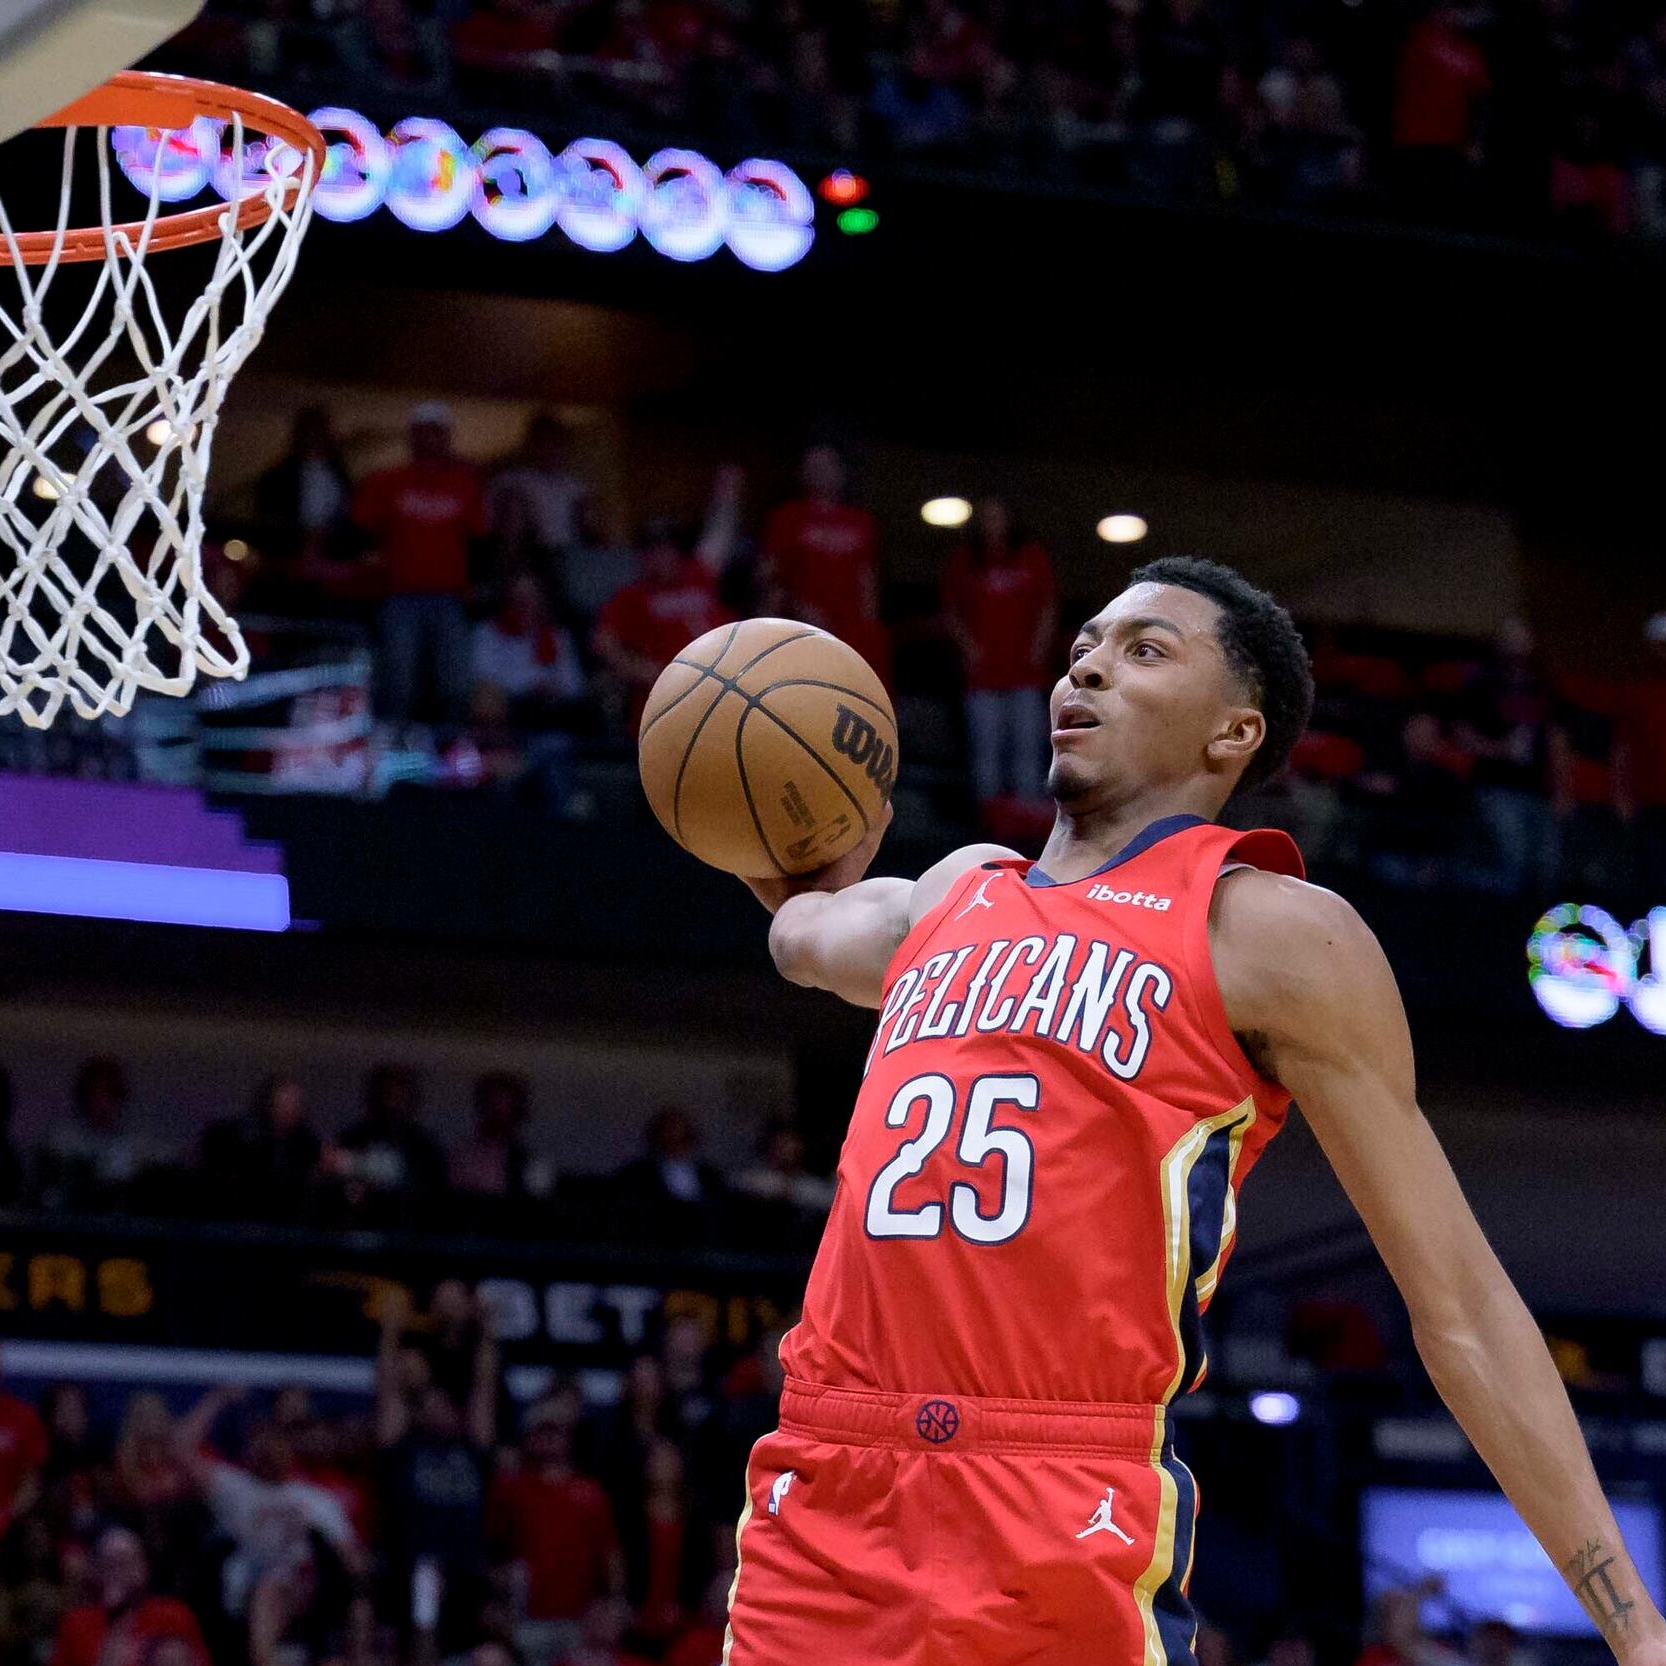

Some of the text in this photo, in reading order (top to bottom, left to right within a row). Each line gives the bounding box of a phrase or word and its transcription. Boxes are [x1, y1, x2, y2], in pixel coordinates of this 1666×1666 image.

[1086, 883, 1172, 913] ibotta
[864, 934, 1174, 1083] PELICANS
[865, 1072, 1041, 1247] 25
